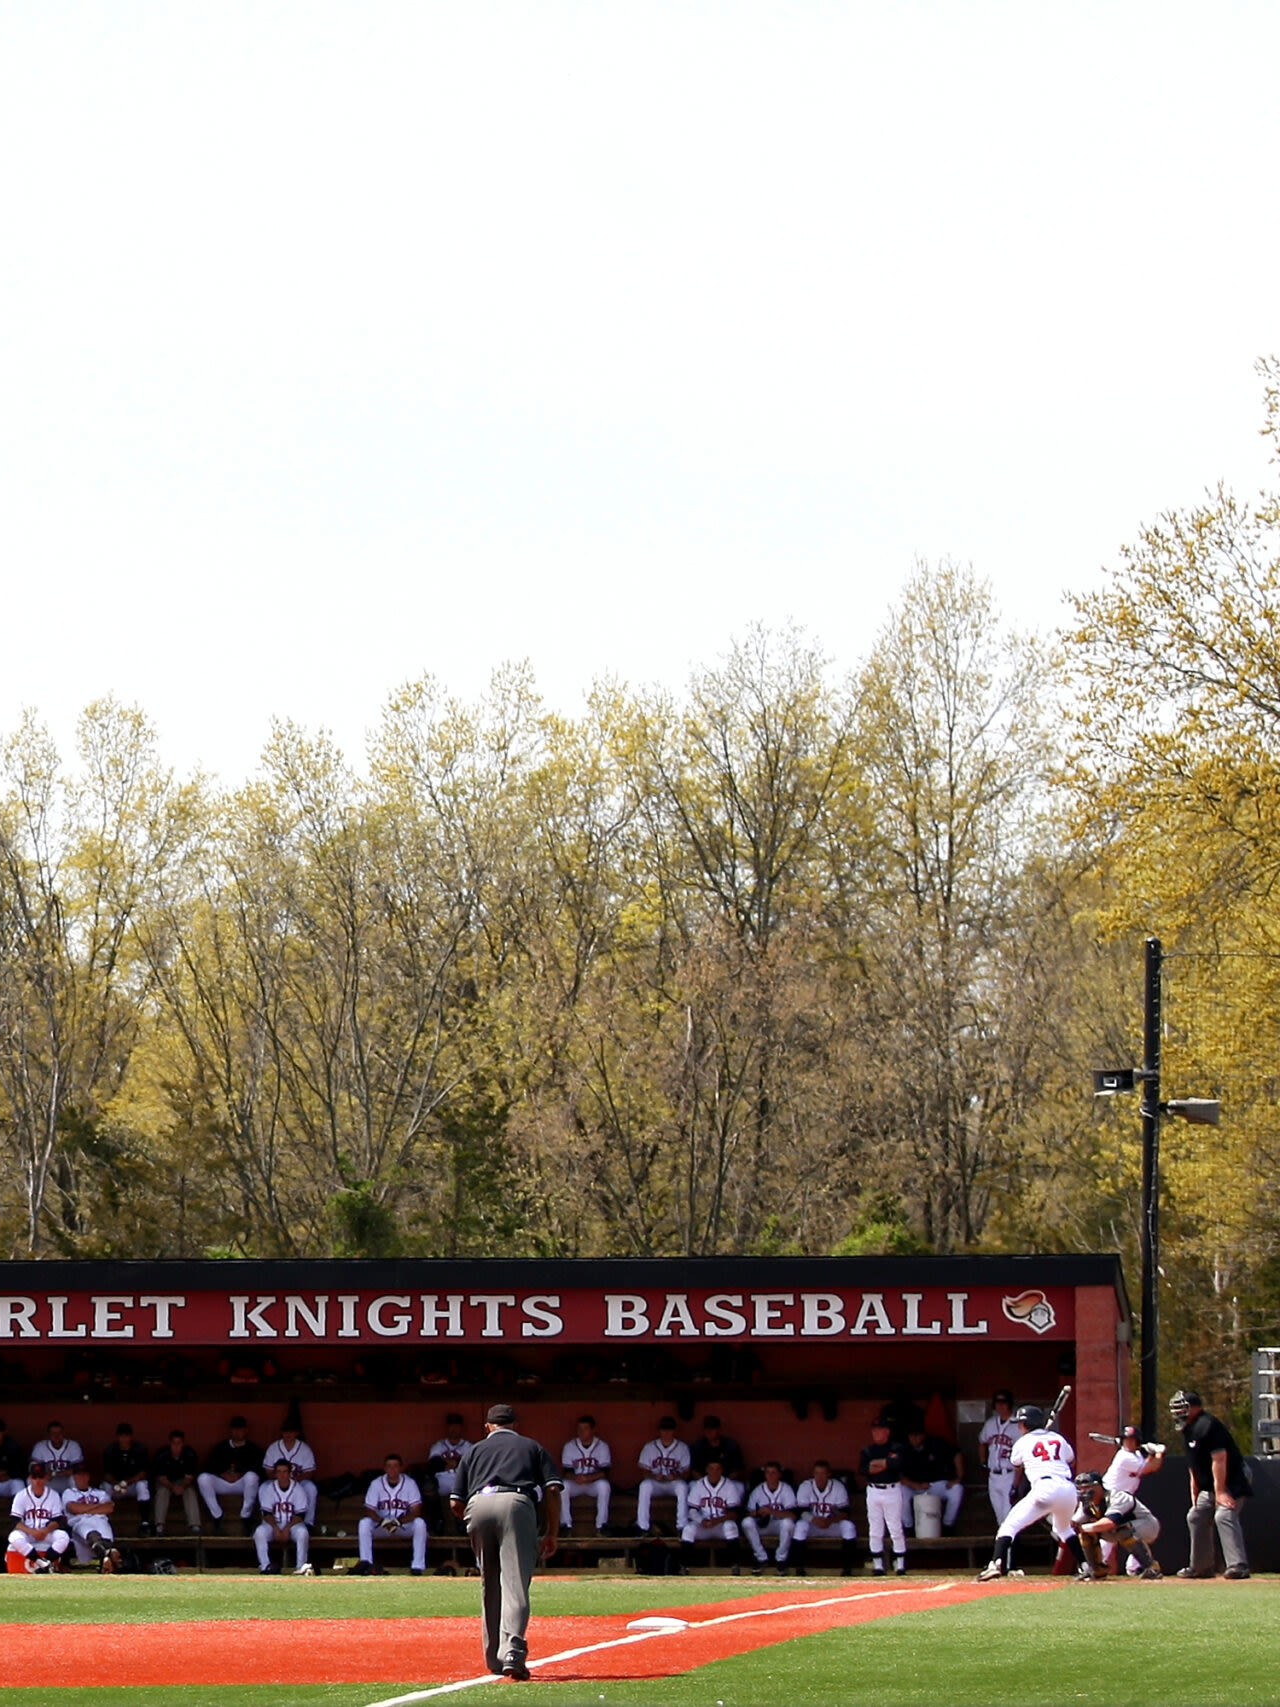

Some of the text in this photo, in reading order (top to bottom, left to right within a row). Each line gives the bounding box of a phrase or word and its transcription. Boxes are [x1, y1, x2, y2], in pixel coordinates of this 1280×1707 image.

[229, 1295, 563, 1338] KNIGHTS
[604, 1293, 988, 1337] BASEBALL
[1032, 1439, 1062, 1462] 47
